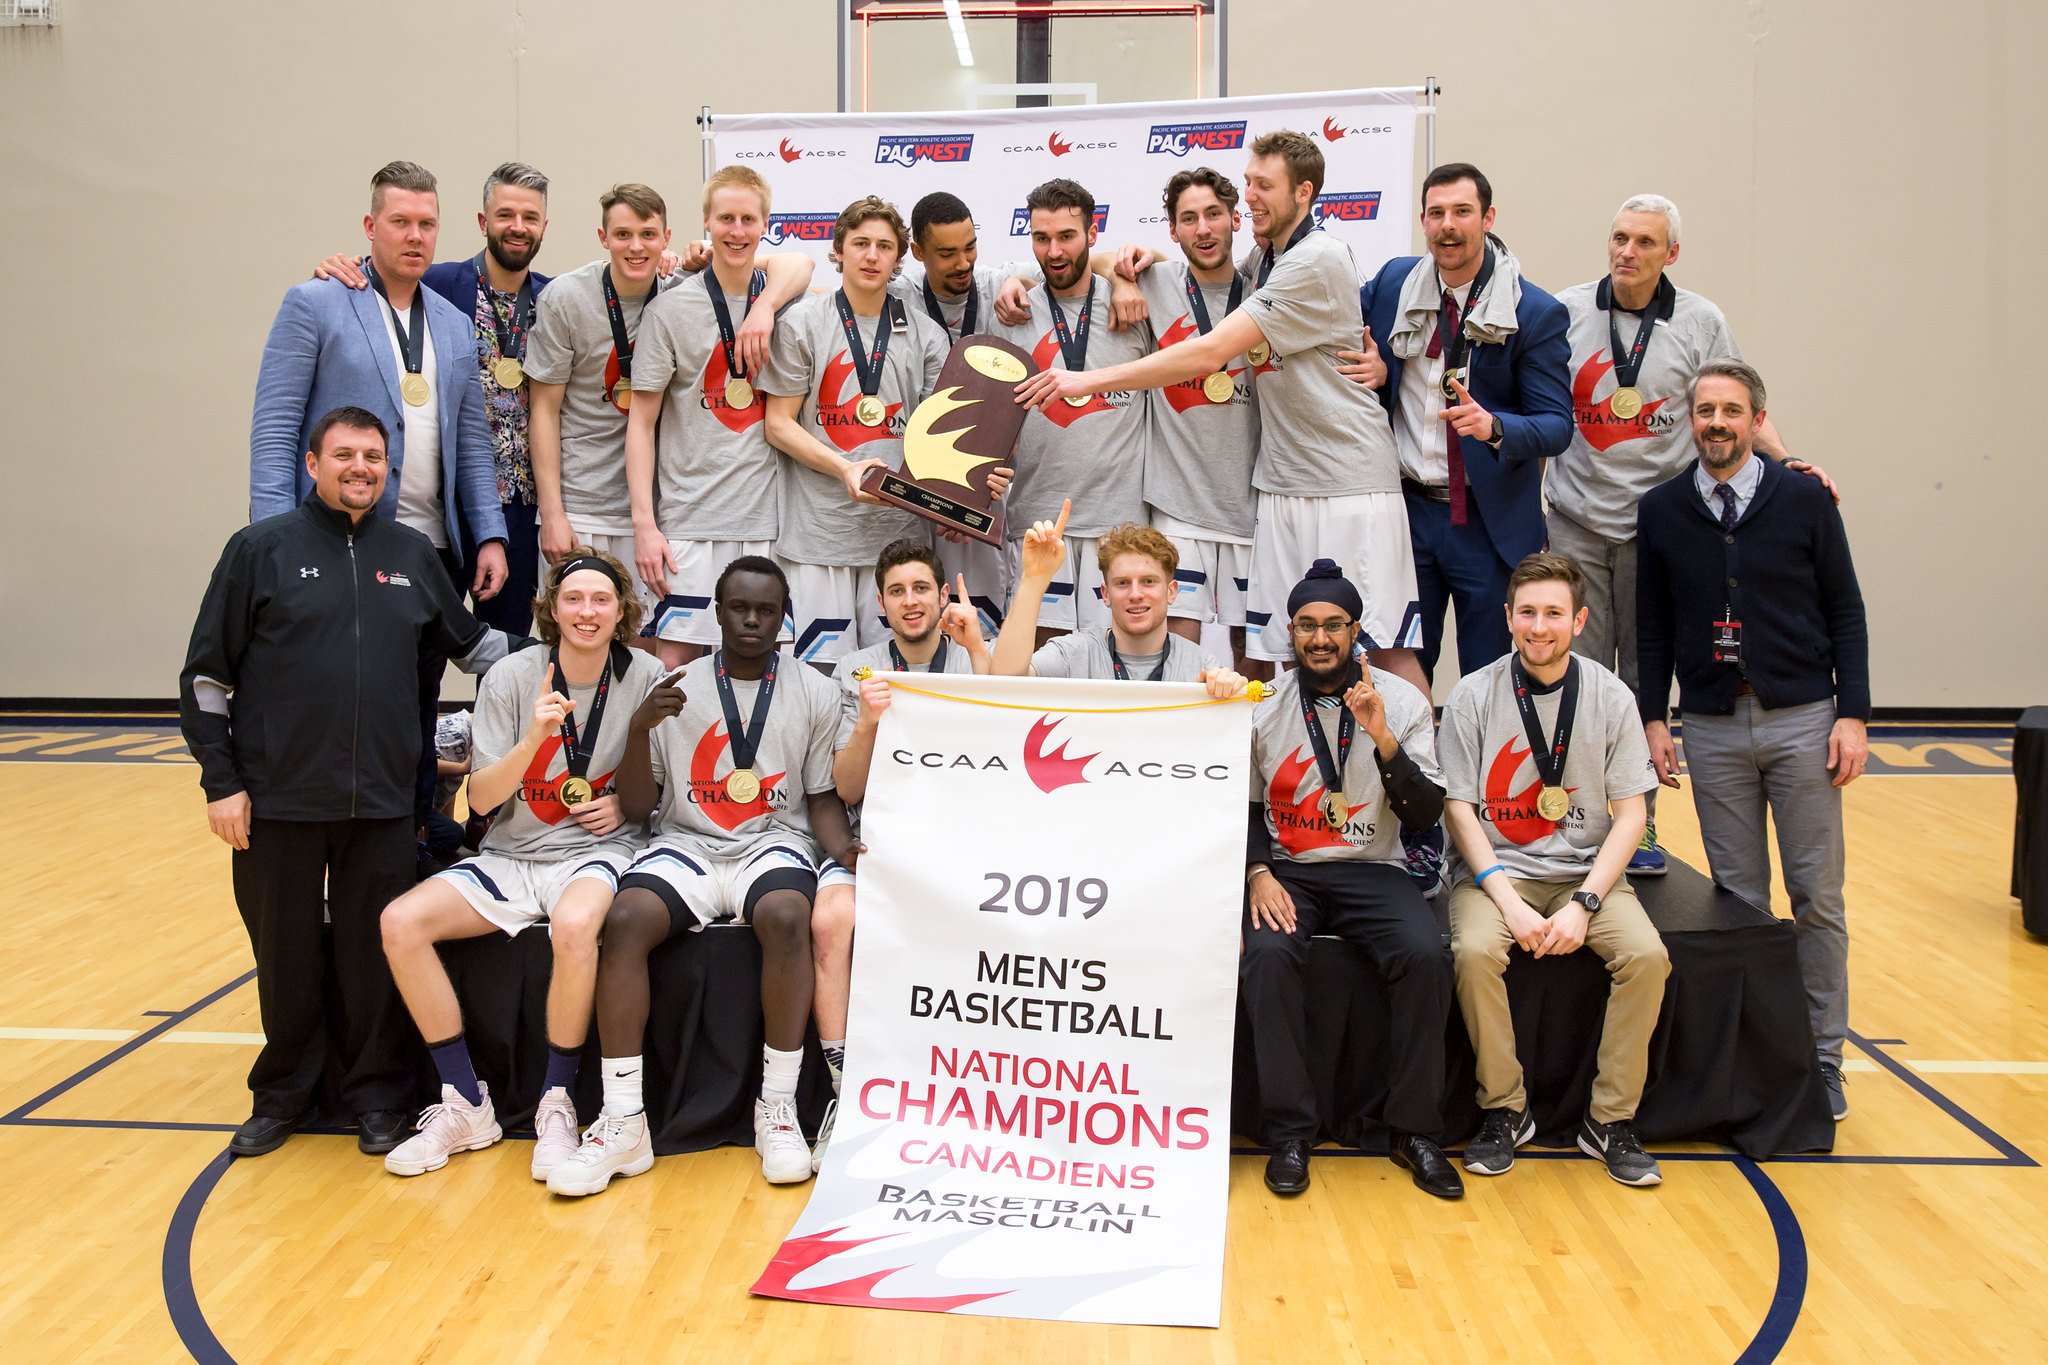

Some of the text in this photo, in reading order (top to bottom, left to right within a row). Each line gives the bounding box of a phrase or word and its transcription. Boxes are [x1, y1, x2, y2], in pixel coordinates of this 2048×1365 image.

[1148, 130, 1243, 153] PACWEST
[1350, 126, 1392, 135] ACSC
[735, 151, 776, 159] CCAA
[876, 143, 971, 163] PACWEST
[1003, 141, 1118, 153] CCAA ACSC
[1139, 216, 1169, 224] CCA
[1311, 201, 1378, 221] CWEST
[768, 221, 837, 240] CWEST
[881, 429, 904, 437] CANAD
[893, 748, 1230, 781] CCAA ACSC
[686, 779, 725, 787] NATIONAL
[979, 872, 1109, 920] 2019
[977, 950, 1107, 992] MEN'S
[910, 985, 1173, 1041] BASKETBALL
[930, 1046, 1140, 1096] NATIONAL
[858, 1078, 1210, 1150] CHAMPIONS
[899, 1140, 1156, 1190] CANADIENS
[877, 1184, 1162, 1219] BASKETBALL
[893, 1208, 1135, 1235] MASCULIN
